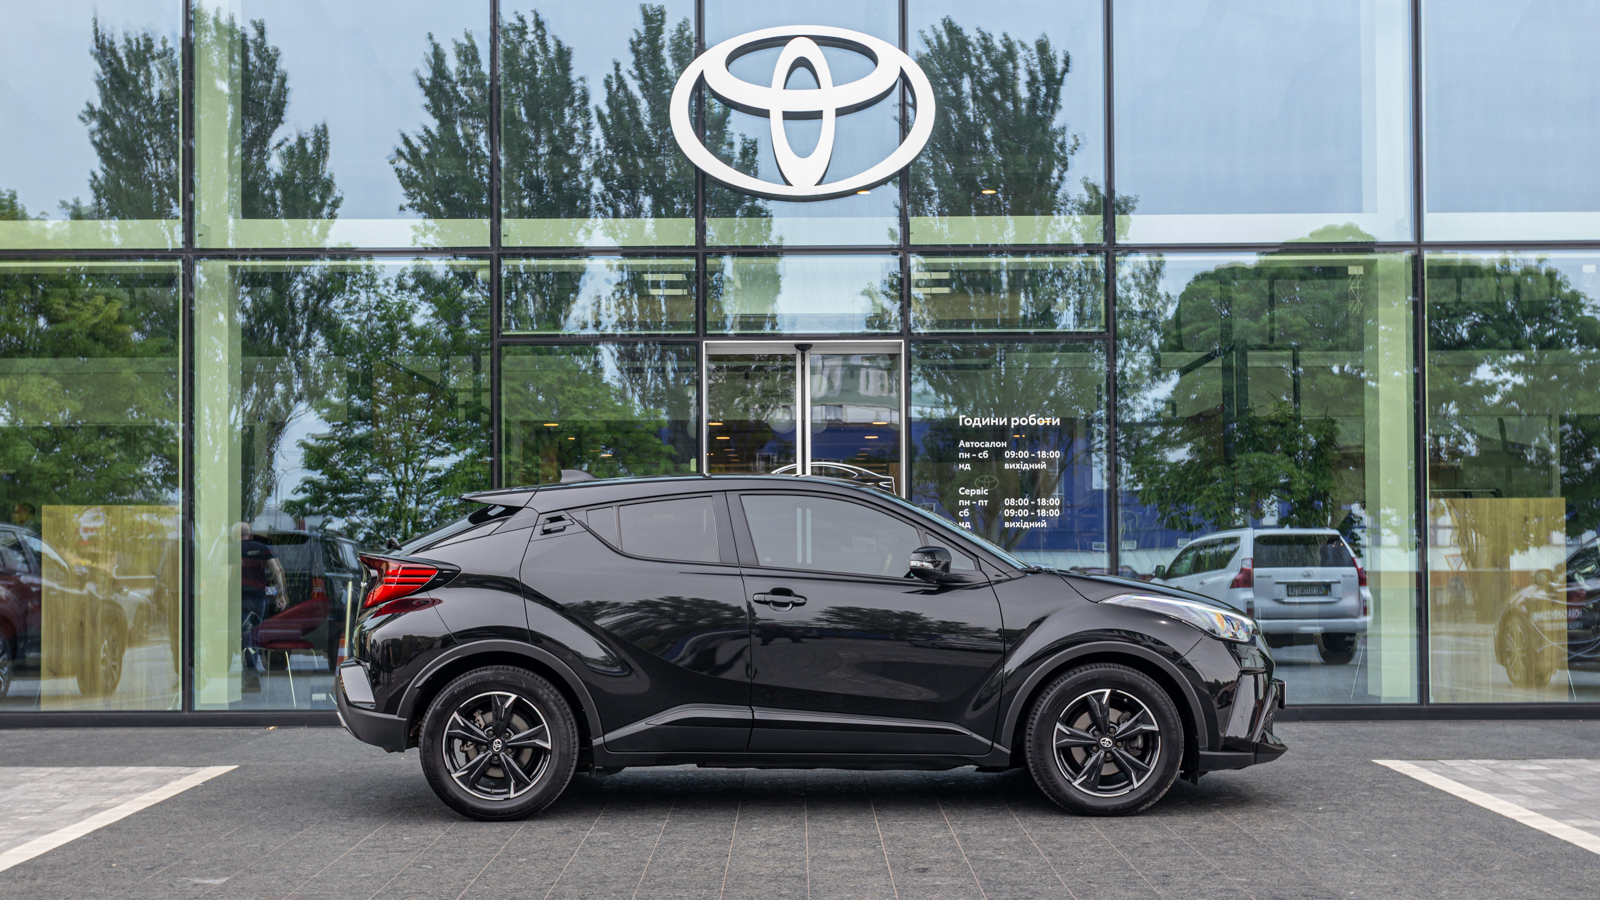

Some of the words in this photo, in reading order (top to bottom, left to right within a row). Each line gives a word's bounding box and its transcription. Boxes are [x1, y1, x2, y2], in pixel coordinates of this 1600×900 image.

[958, 414, 1008, 428] Години
[1011, 414, 1061, 429] роботи
[958, 440, 1007, 448] Автосалон
[978, 450, 989, 459] сб
[1004, 450, 1029, 459] 09:00
[1037, 450, 1061, 459] 18:00
[958, 463, 971, 471] нд
[1004, 461, 1047, 471] вихідний
[958, 487, 989, 497] Сервіс
[1004, 497, 1029, 506] 08:00
[1036, 497, 1061, 506] 18:00
[958, 508, 970, 517] сб
[1004, 508, 1029, 517] 09:00
[1036, 508, 1060, 517] 18:00
[958, 521, 971, 529] нд
[1004, 519, 1047, 529] вихідний
